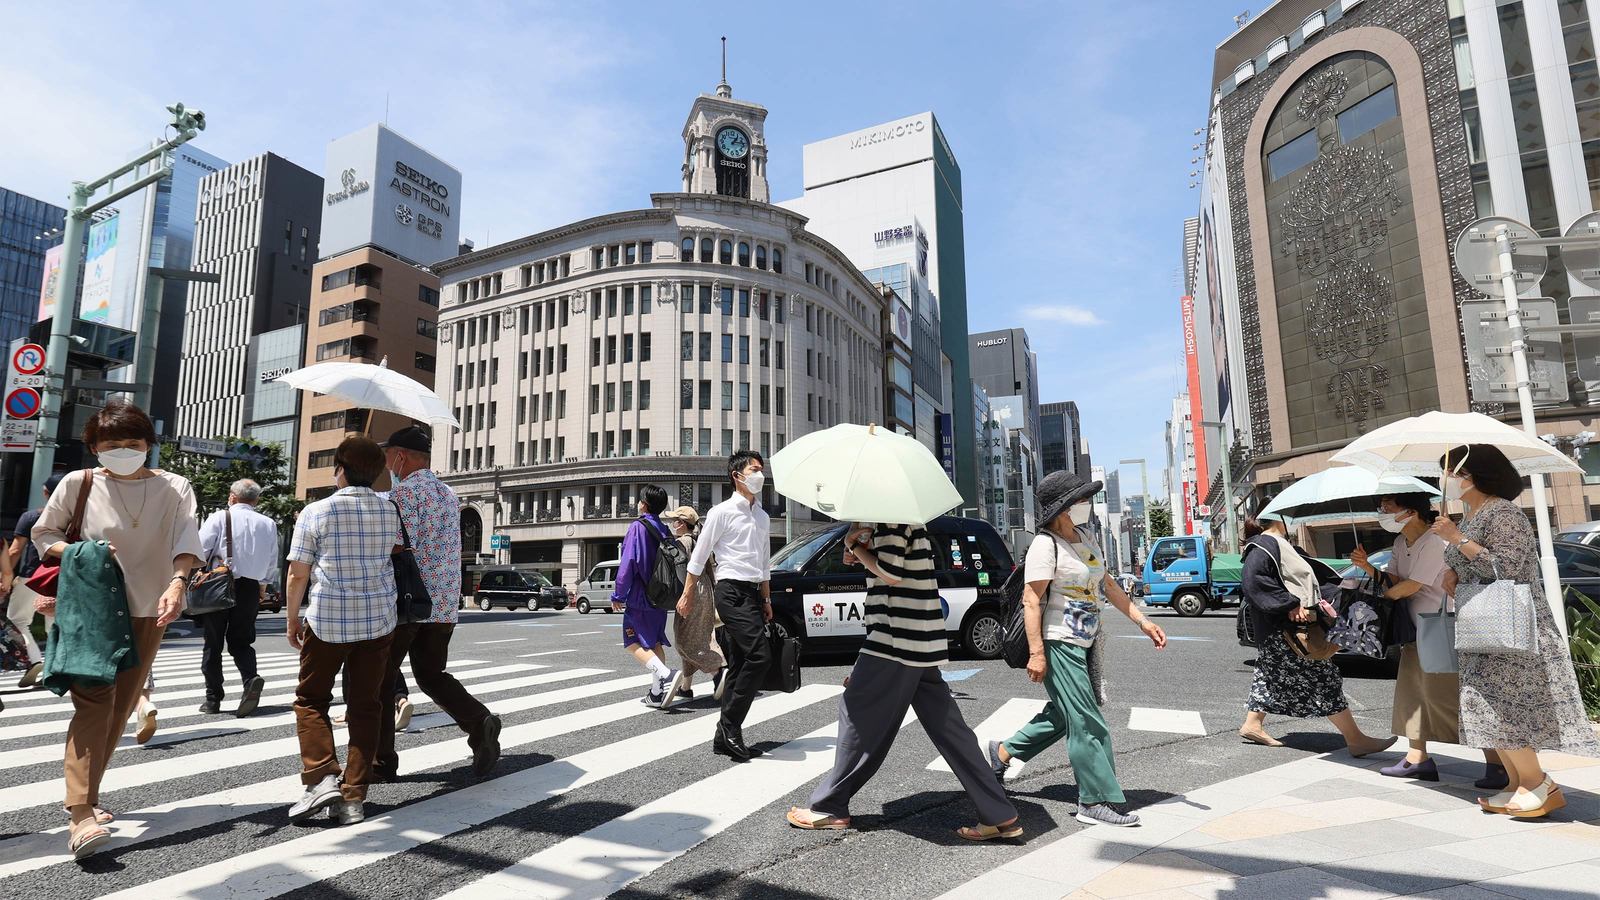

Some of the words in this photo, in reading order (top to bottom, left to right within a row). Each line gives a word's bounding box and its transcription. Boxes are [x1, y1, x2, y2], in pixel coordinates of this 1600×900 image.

[850, 120, 925, 149] MIKIMOTO
[182, 154, 218, 172] TENSHOD
[720, 160, 746, 169] SEIKO
[395, 160, 448, 199] SEIKO
[390, 177, 450, 217] ASTRON
[417, 213, 443, 233] GPS
[417, 223, 442, 240] SOLAR
[1183, 299, 1195, 355] MITSUKOSHI
[977, 337, 1008, 348] HUBLOT
[261, 367, 292, 381] SEIKO
[834, 602, 866, 621] TA
